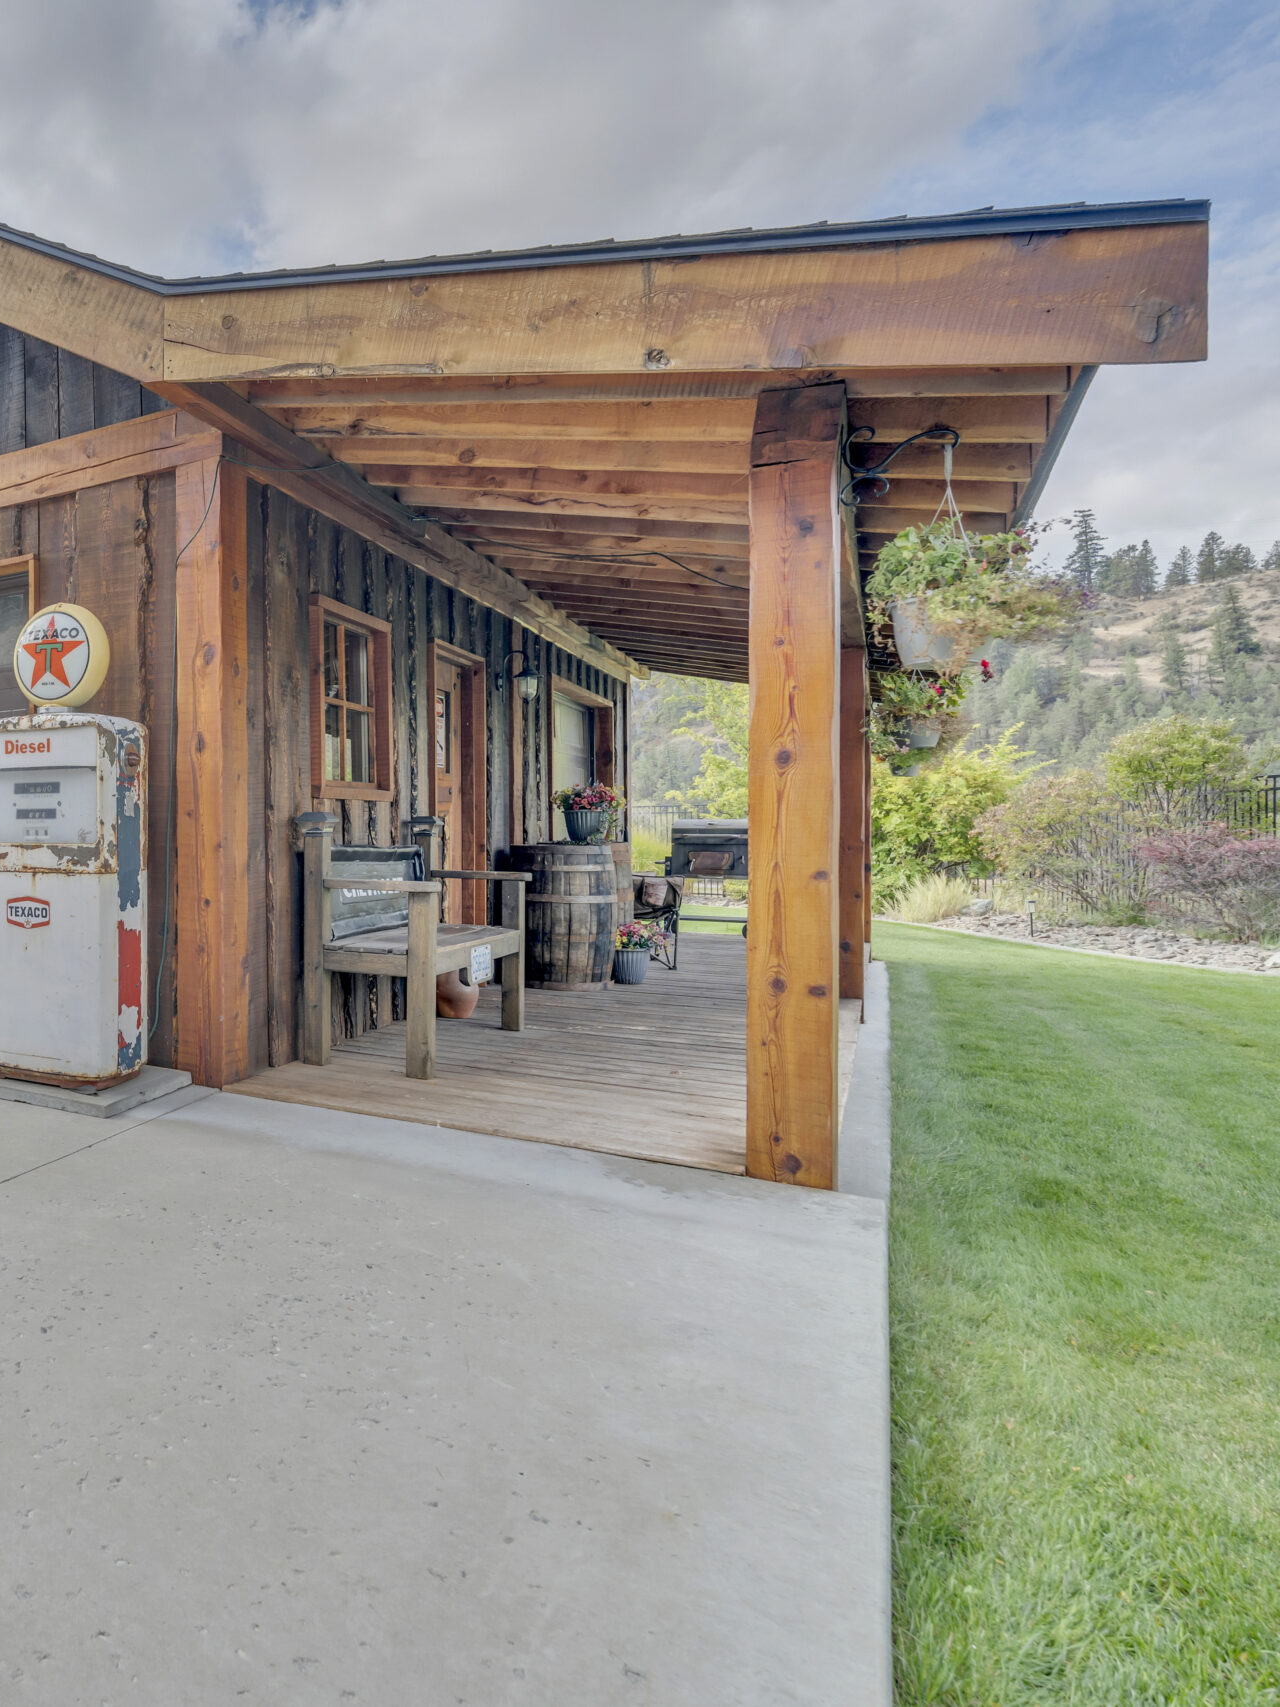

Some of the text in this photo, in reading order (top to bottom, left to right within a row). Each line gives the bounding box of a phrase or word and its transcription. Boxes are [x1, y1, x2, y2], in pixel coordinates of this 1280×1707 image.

[28, 627, 80, 641] TEXACO
[4, 738, 51, 754] Diesel
[8, 905, 48, 918] TEXACO
